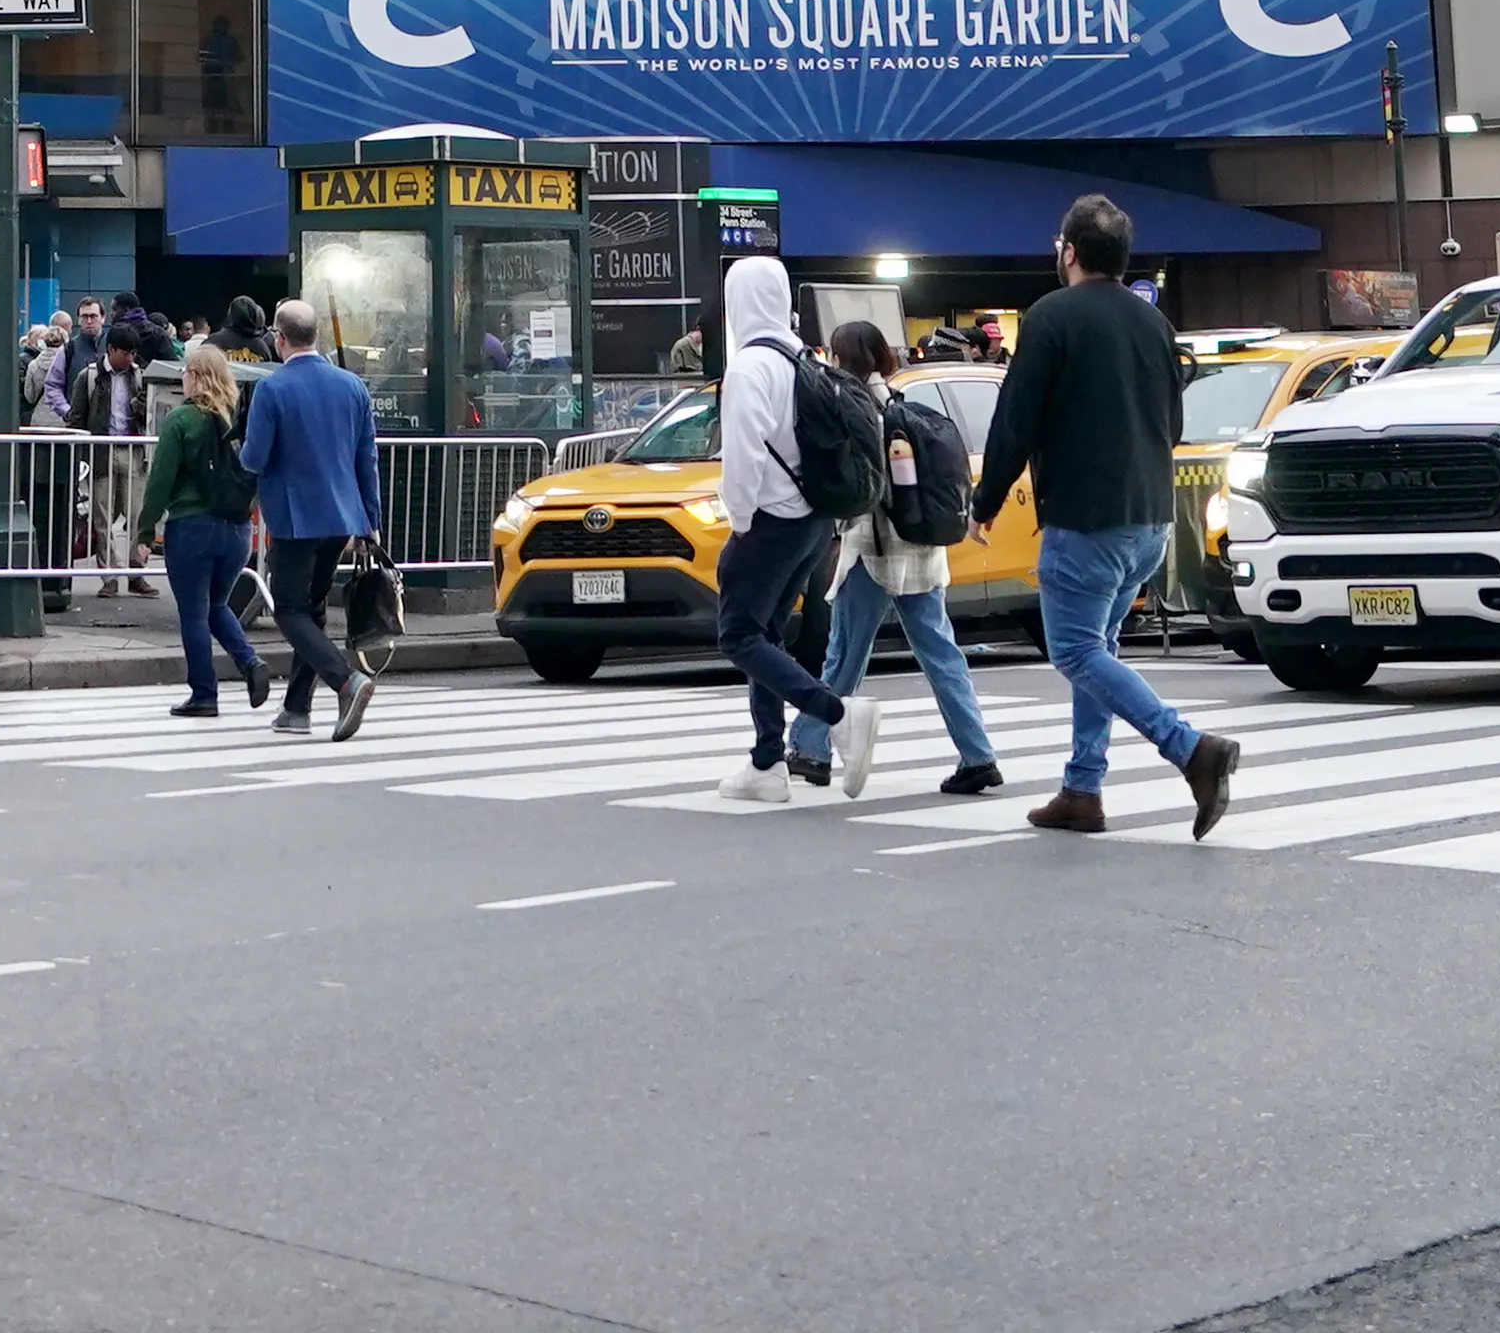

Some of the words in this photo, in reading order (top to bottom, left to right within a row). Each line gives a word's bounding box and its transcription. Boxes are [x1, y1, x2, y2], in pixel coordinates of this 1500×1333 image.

[636, 59, 679, 72] THE
[687, 58, 789, 72] WORLD'S
[798, 57, 860, 70] MOST
[869, 56, 960, 70] FAMOUS
[969, 55, 1041, 68] ARENA
[308, 169, 387, 206] TAXI
[454, 169, 532, 205] TAXI
[730, 206, 753, 218] Street
[720, 217, 740, 228] Penn
[740, 218, 767, 229] Station
[722, 231, 730, 242] A
[745, 231, 752, 242] E
[608, 249, 673, 279] GARDEN
[370, 395, 398, 410] reet
[1326, 471, 1424, 491] RAM
[1354, 597, 1378, 615] XKR
[1386, 597, 1411, 615] C82
